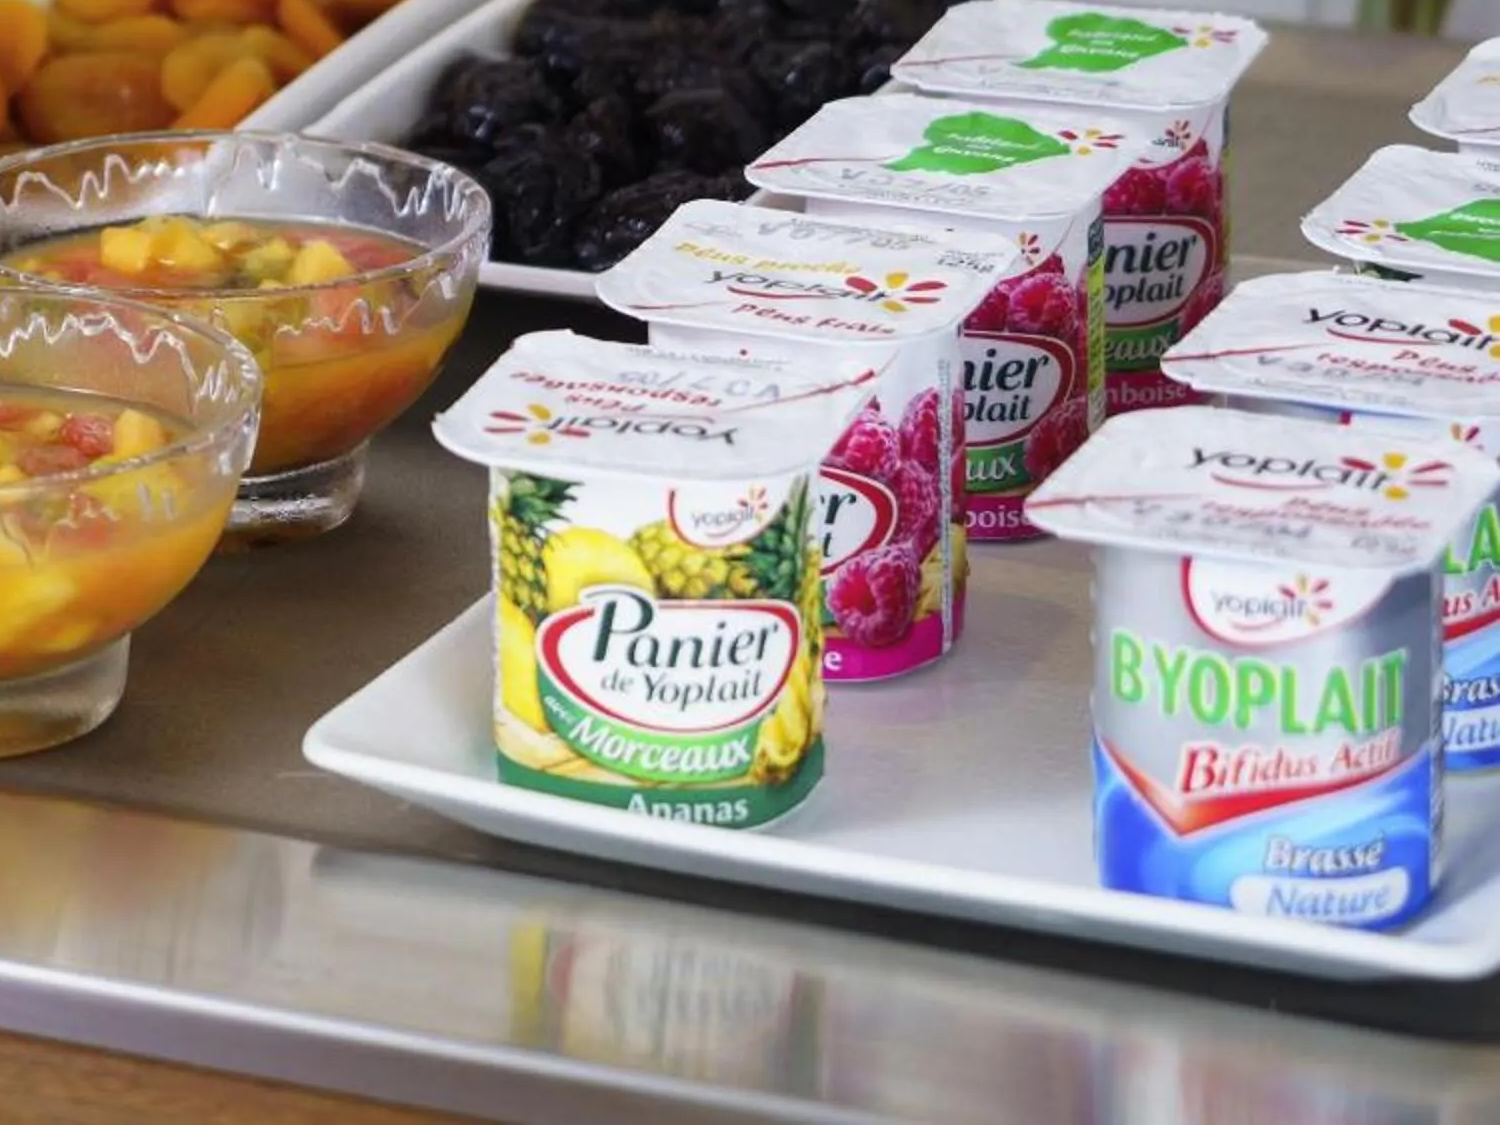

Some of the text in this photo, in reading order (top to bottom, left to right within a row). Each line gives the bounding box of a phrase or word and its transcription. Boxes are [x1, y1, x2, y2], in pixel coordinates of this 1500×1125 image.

[1104, 232, 1197, 274] nier
[1103, 275, 1184, 310] oplait
[1189, 447, 1394, 491] yoplait
[586, 589, 780, 670] Panier
[601, 669, 762, 711] de Yoplait
[567, 714, 751, 773] Morceaux
[1180, 743, 1318, 794] Bifidus
[627, 792, 750, 823] Ananas
[1266, 883, 1390, 917] Nature
